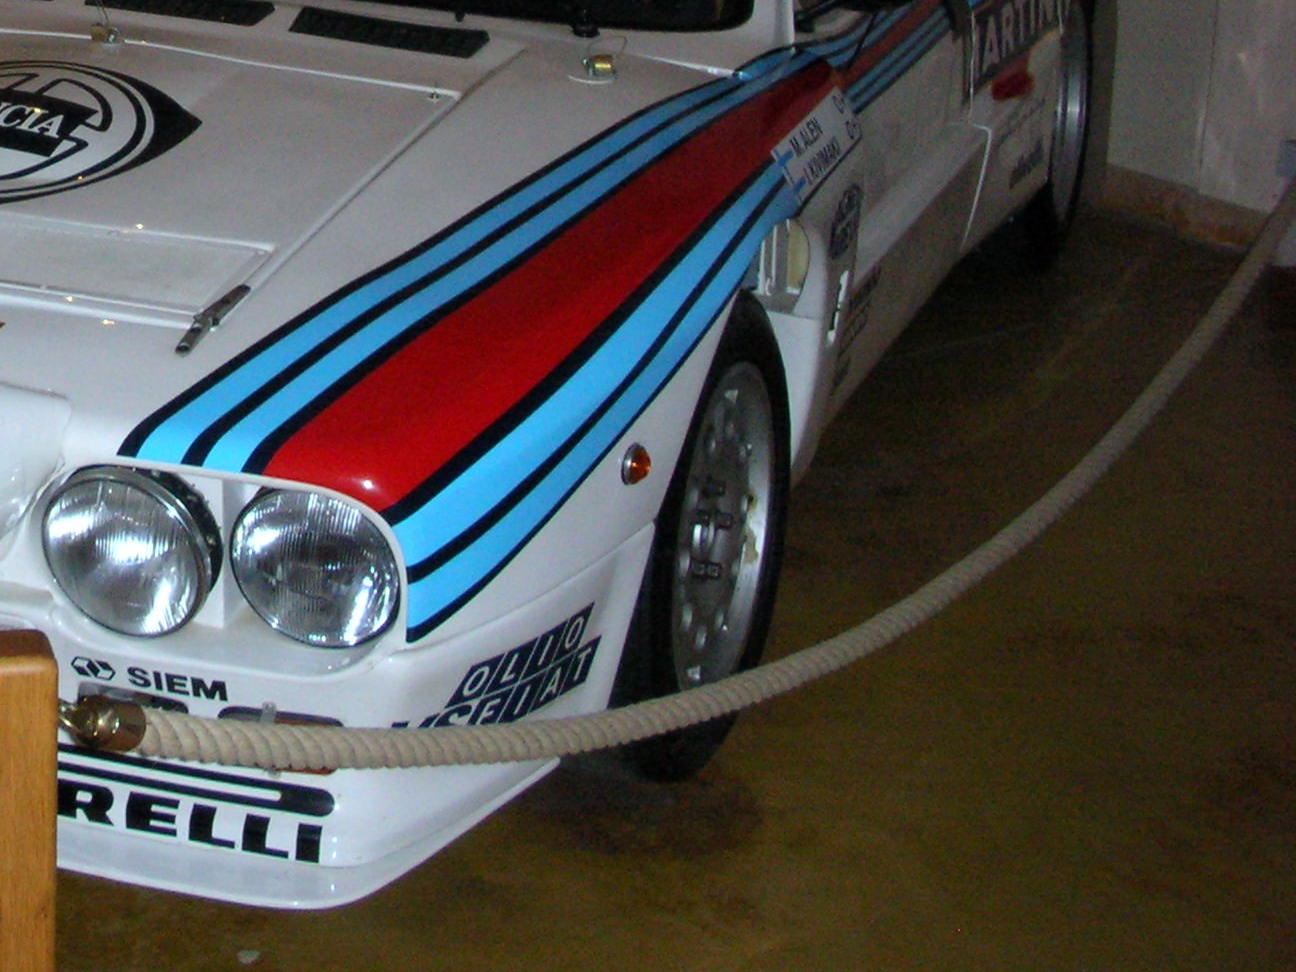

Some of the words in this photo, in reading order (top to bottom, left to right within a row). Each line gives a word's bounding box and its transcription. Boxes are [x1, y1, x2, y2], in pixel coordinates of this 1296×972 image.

[128, 666, 229, 703] SIEM
[462, 616, 585, 698] OLIO
[477, 646, 592, 725] FIAT
